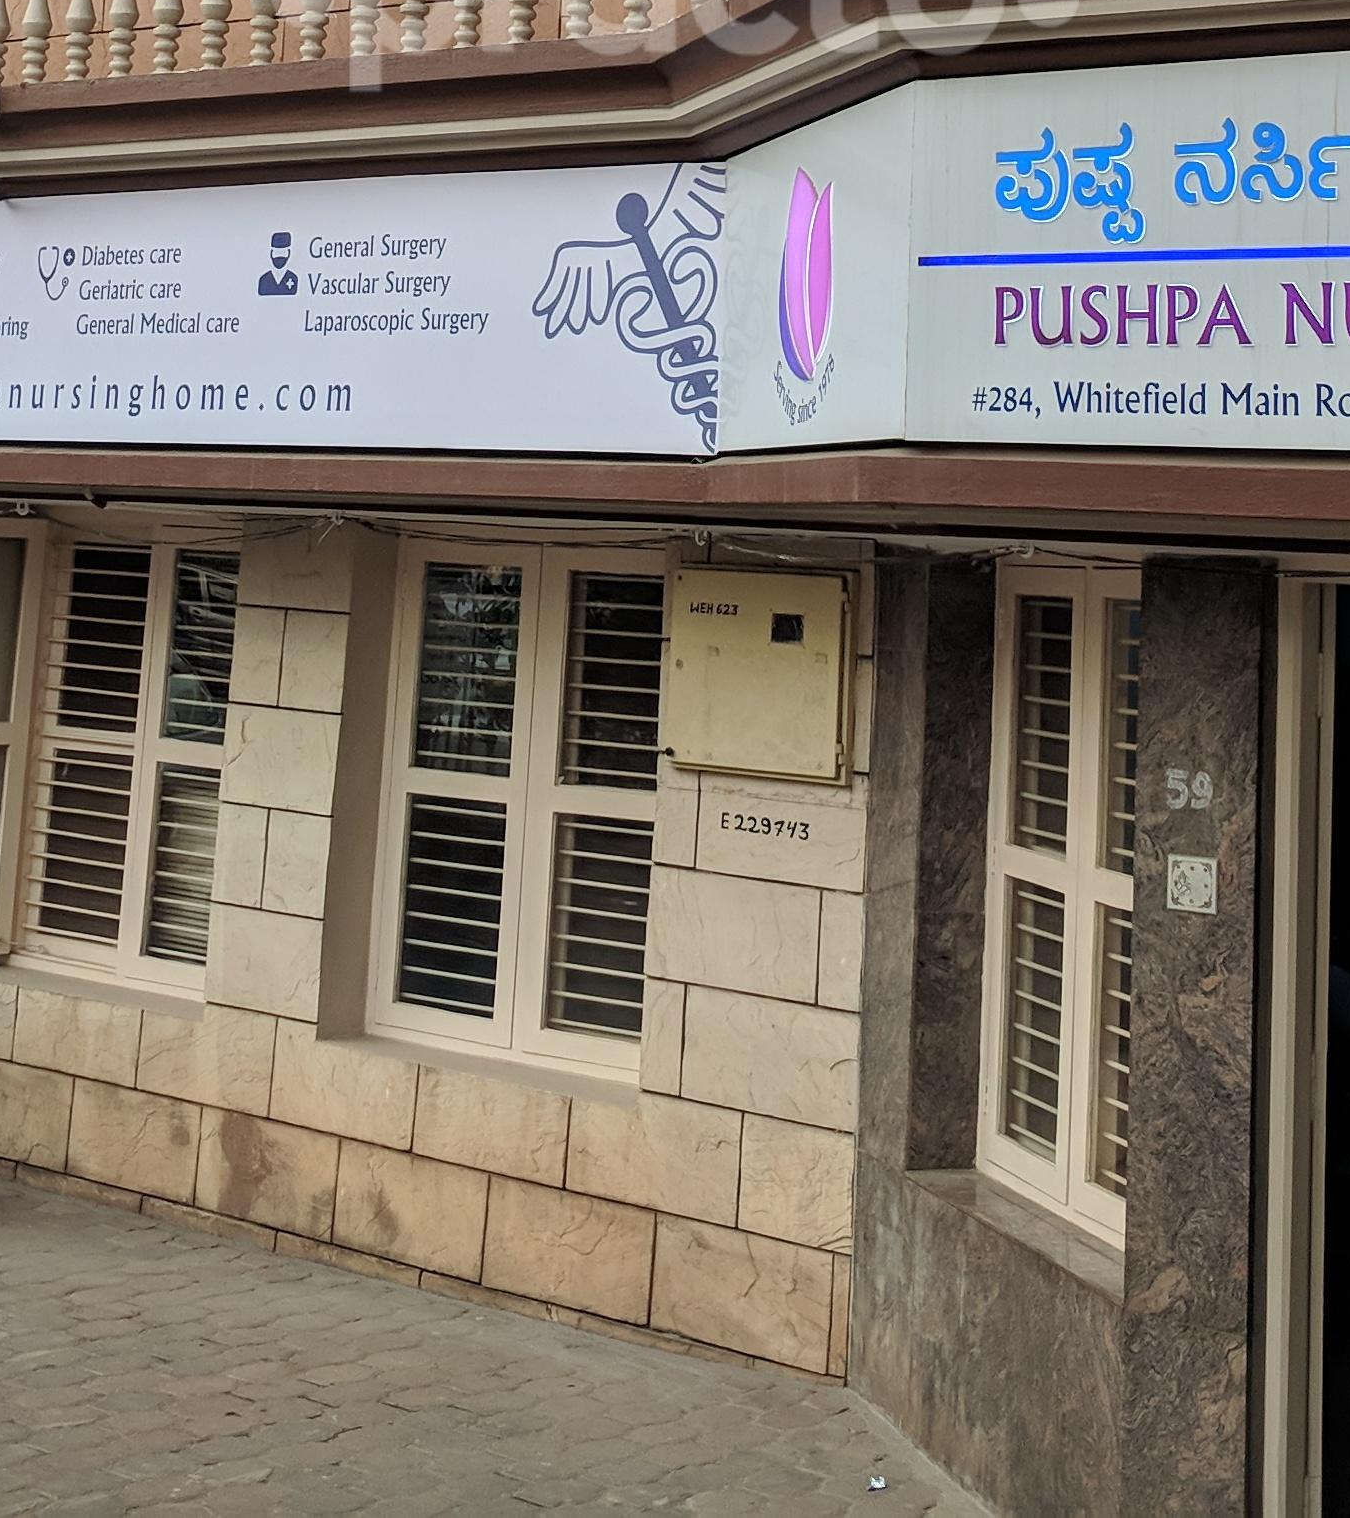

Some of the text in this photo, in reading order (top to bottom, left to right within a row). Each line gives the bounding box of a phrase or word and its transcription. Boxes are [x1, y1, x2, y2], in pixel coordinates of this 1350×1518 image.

[995, 122, 1146, 244] ಪುಷ್ಪ
[81, 245, 182, 267] Diabetes care
[309, 234, 447, 260] General Surgery
[79, 278, 182, 300] Geriatric care
[308, 271, 451, 297] Vascular Surgery
[76, 312, 240, 335] General Medical care
[304, 308, 489, 336] Laparoscopic Surgery
[993, 283, 1254, 347] PUSHPA
[773, 354, 835, 426] Serving since 1978
[972, 386, 1041, 420] #284,
[1053, 381, 1207, 416] Whitefield
[1221, 381, 1300, 417] Main
[690, 602, 738, 615] WEH 623
[1165, 768, 1214, 810] 59
